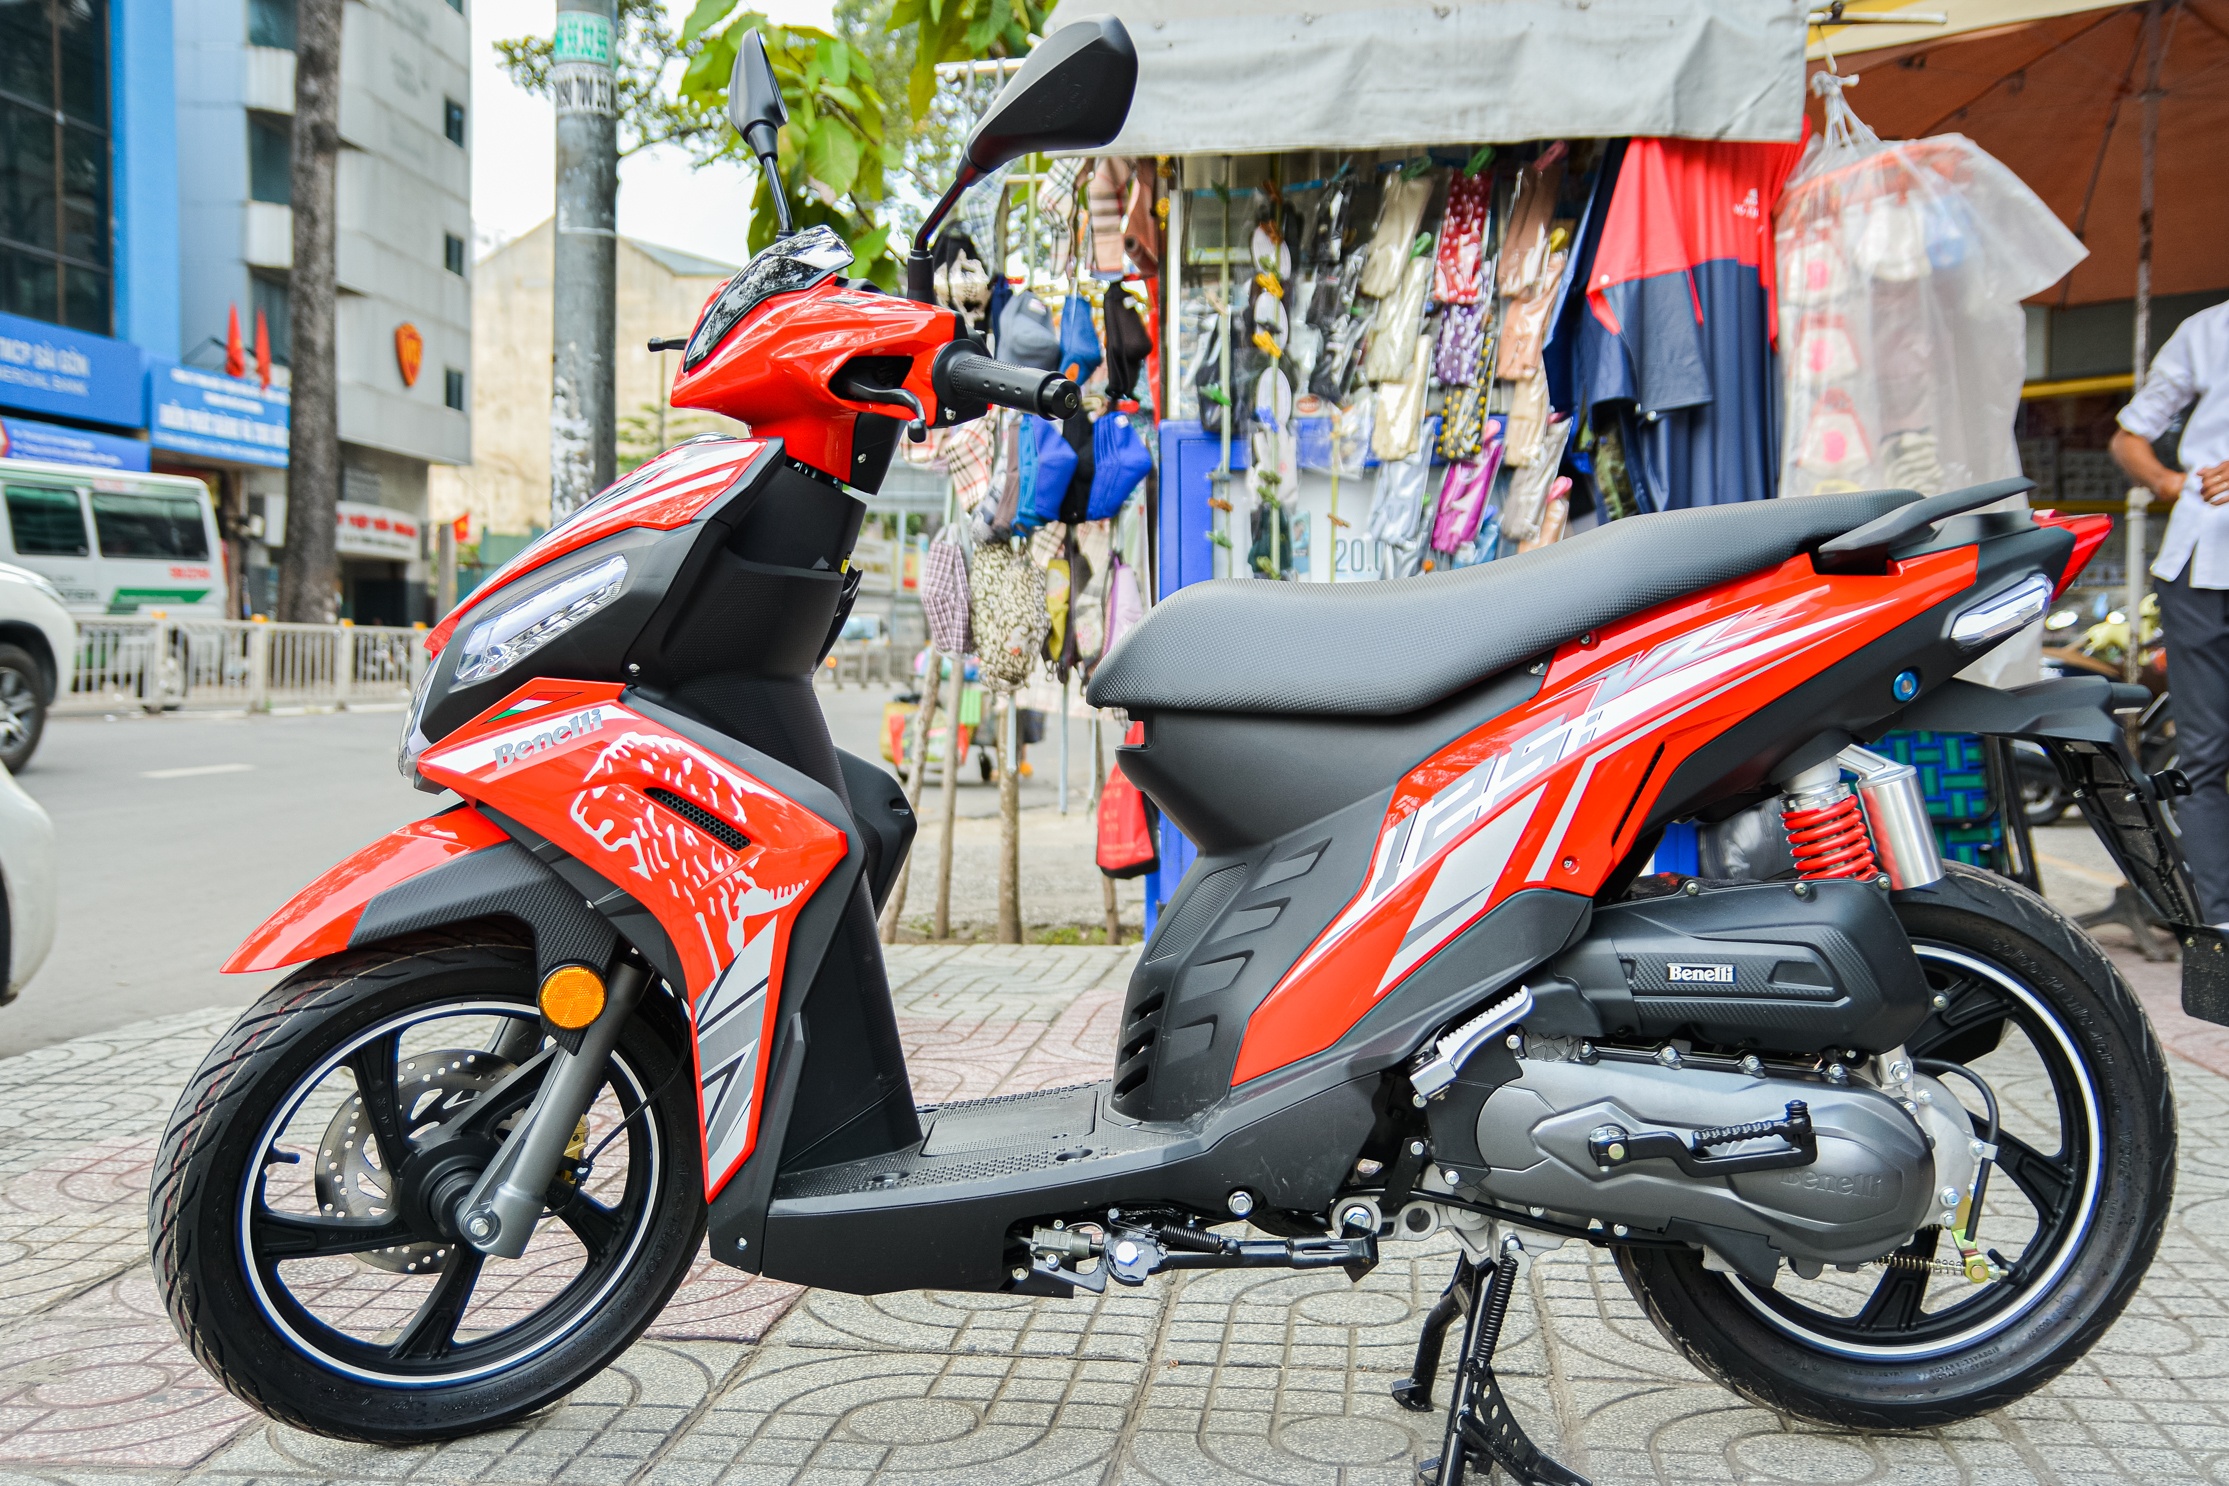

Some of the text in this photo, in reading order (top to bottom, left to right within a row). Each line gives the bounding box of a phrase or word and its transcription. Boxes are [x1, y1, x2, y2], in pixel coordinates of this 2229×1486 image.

[493, 708, 603, 771] Benelli
[1668, 965, 1735, 983] Benelli
[1780, 1168, 1883, 1199] Benelli
